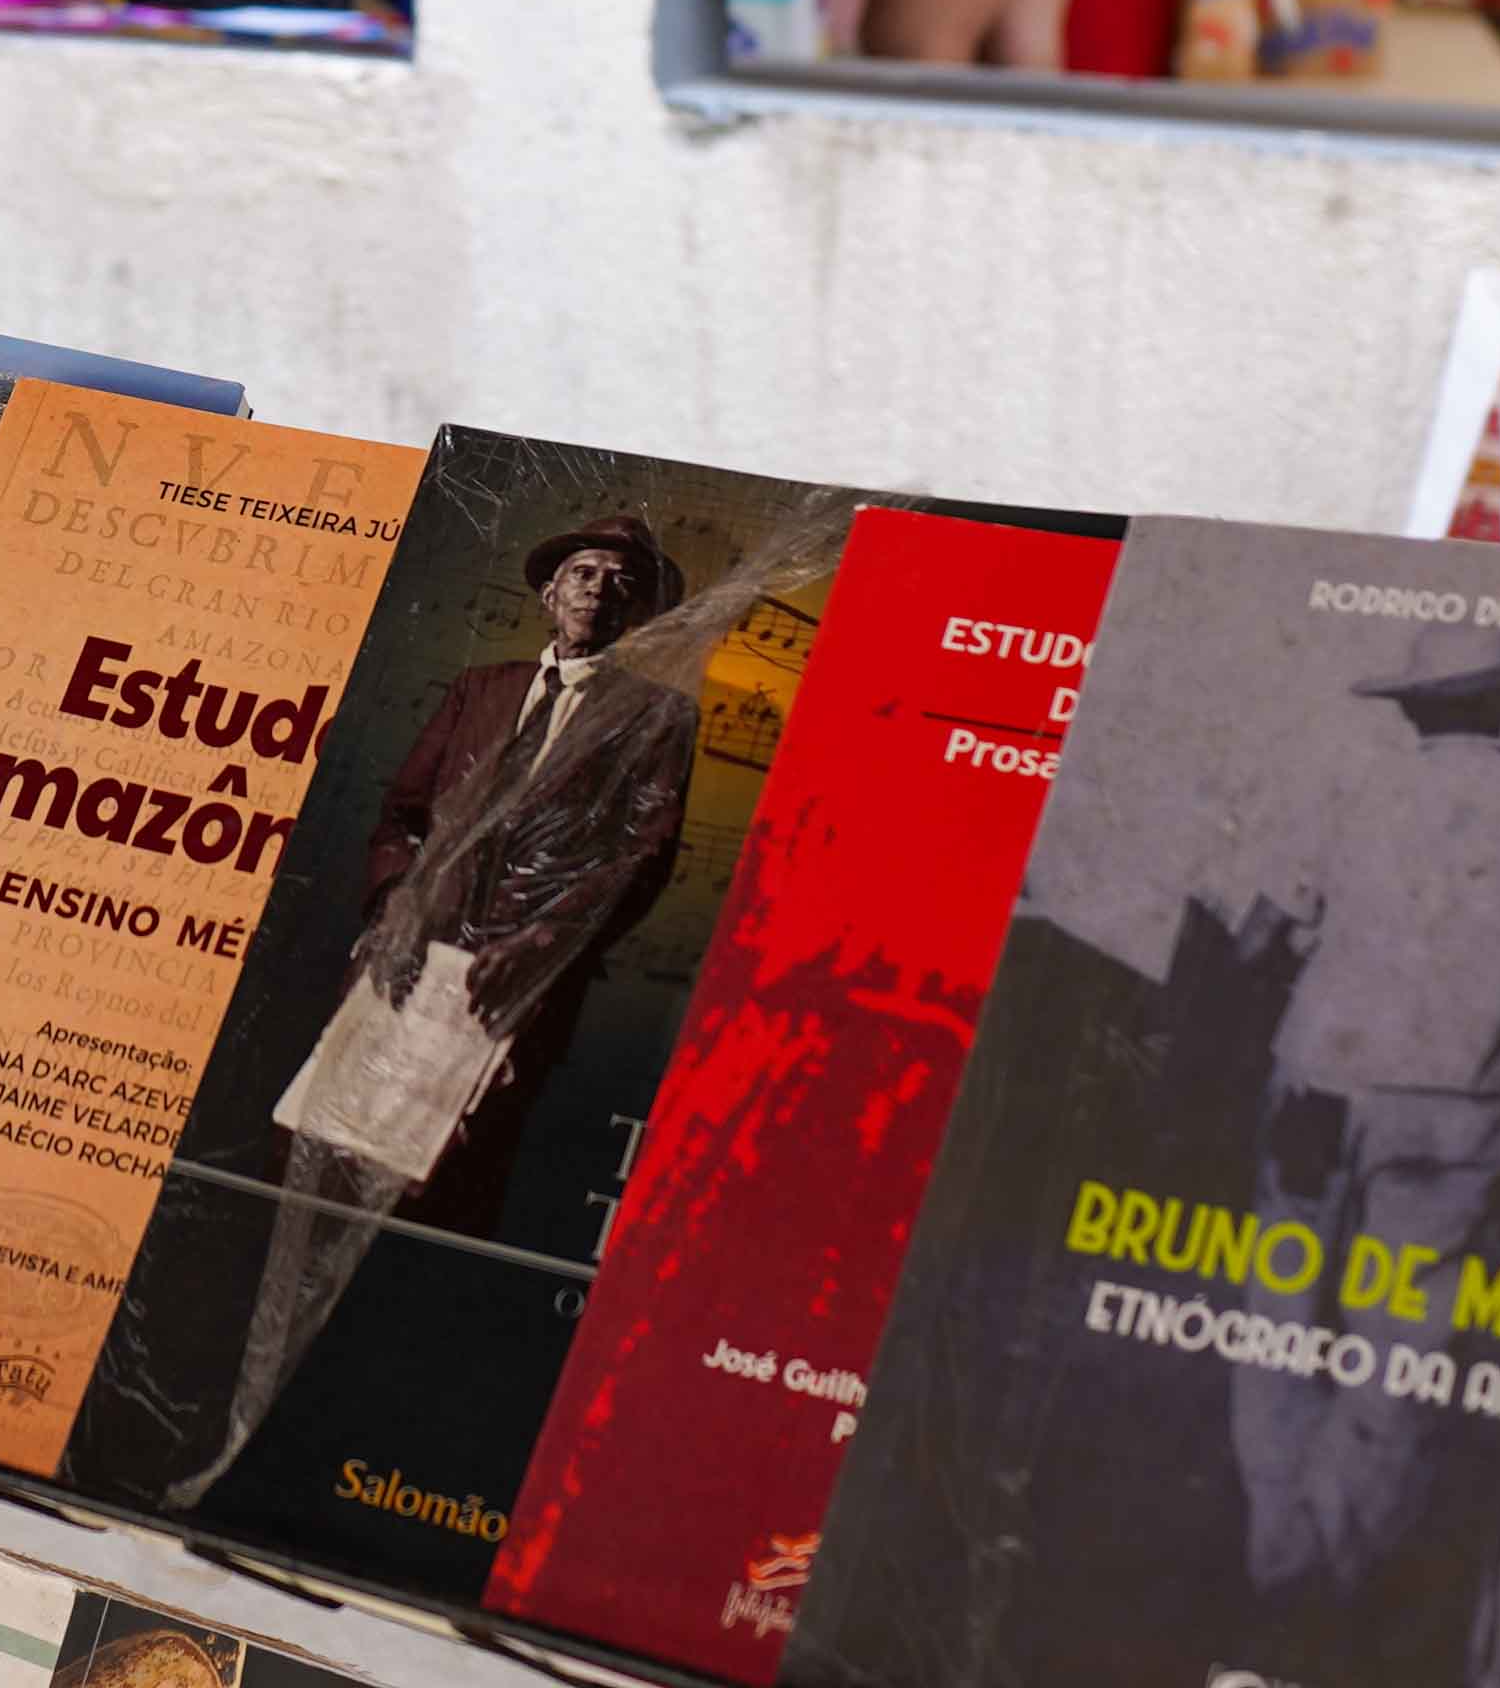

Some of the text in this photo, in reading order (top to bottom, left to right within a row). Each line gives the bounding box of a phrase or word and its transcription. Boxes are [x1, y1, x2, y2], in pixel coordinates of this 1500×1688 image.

[158, 480, 231, 513] TIESE
[238, 496, 358, 536] TEIXEIRA
[1308, 580, 1467, 624] RODRIGO
[58, 635, 335, 764] Estud
[176, 915, 254, 964] MÉ
[36, 1020, 193, 1075] Apresentação:
[32, 1059, 104, 1095] D'ARC
[78, 1142, 168, 1181] ROCHA
[64, 1263, 81, 1286] E
[1065, 1180, 1323, 1295] BRUNO
[1340, 1235, 1438, 1321] DE
[702, 1338, 778, 1383] José
[1384, 1344, 1456, 1404] DA
[334, 1458, 508, 1543] Salomão
